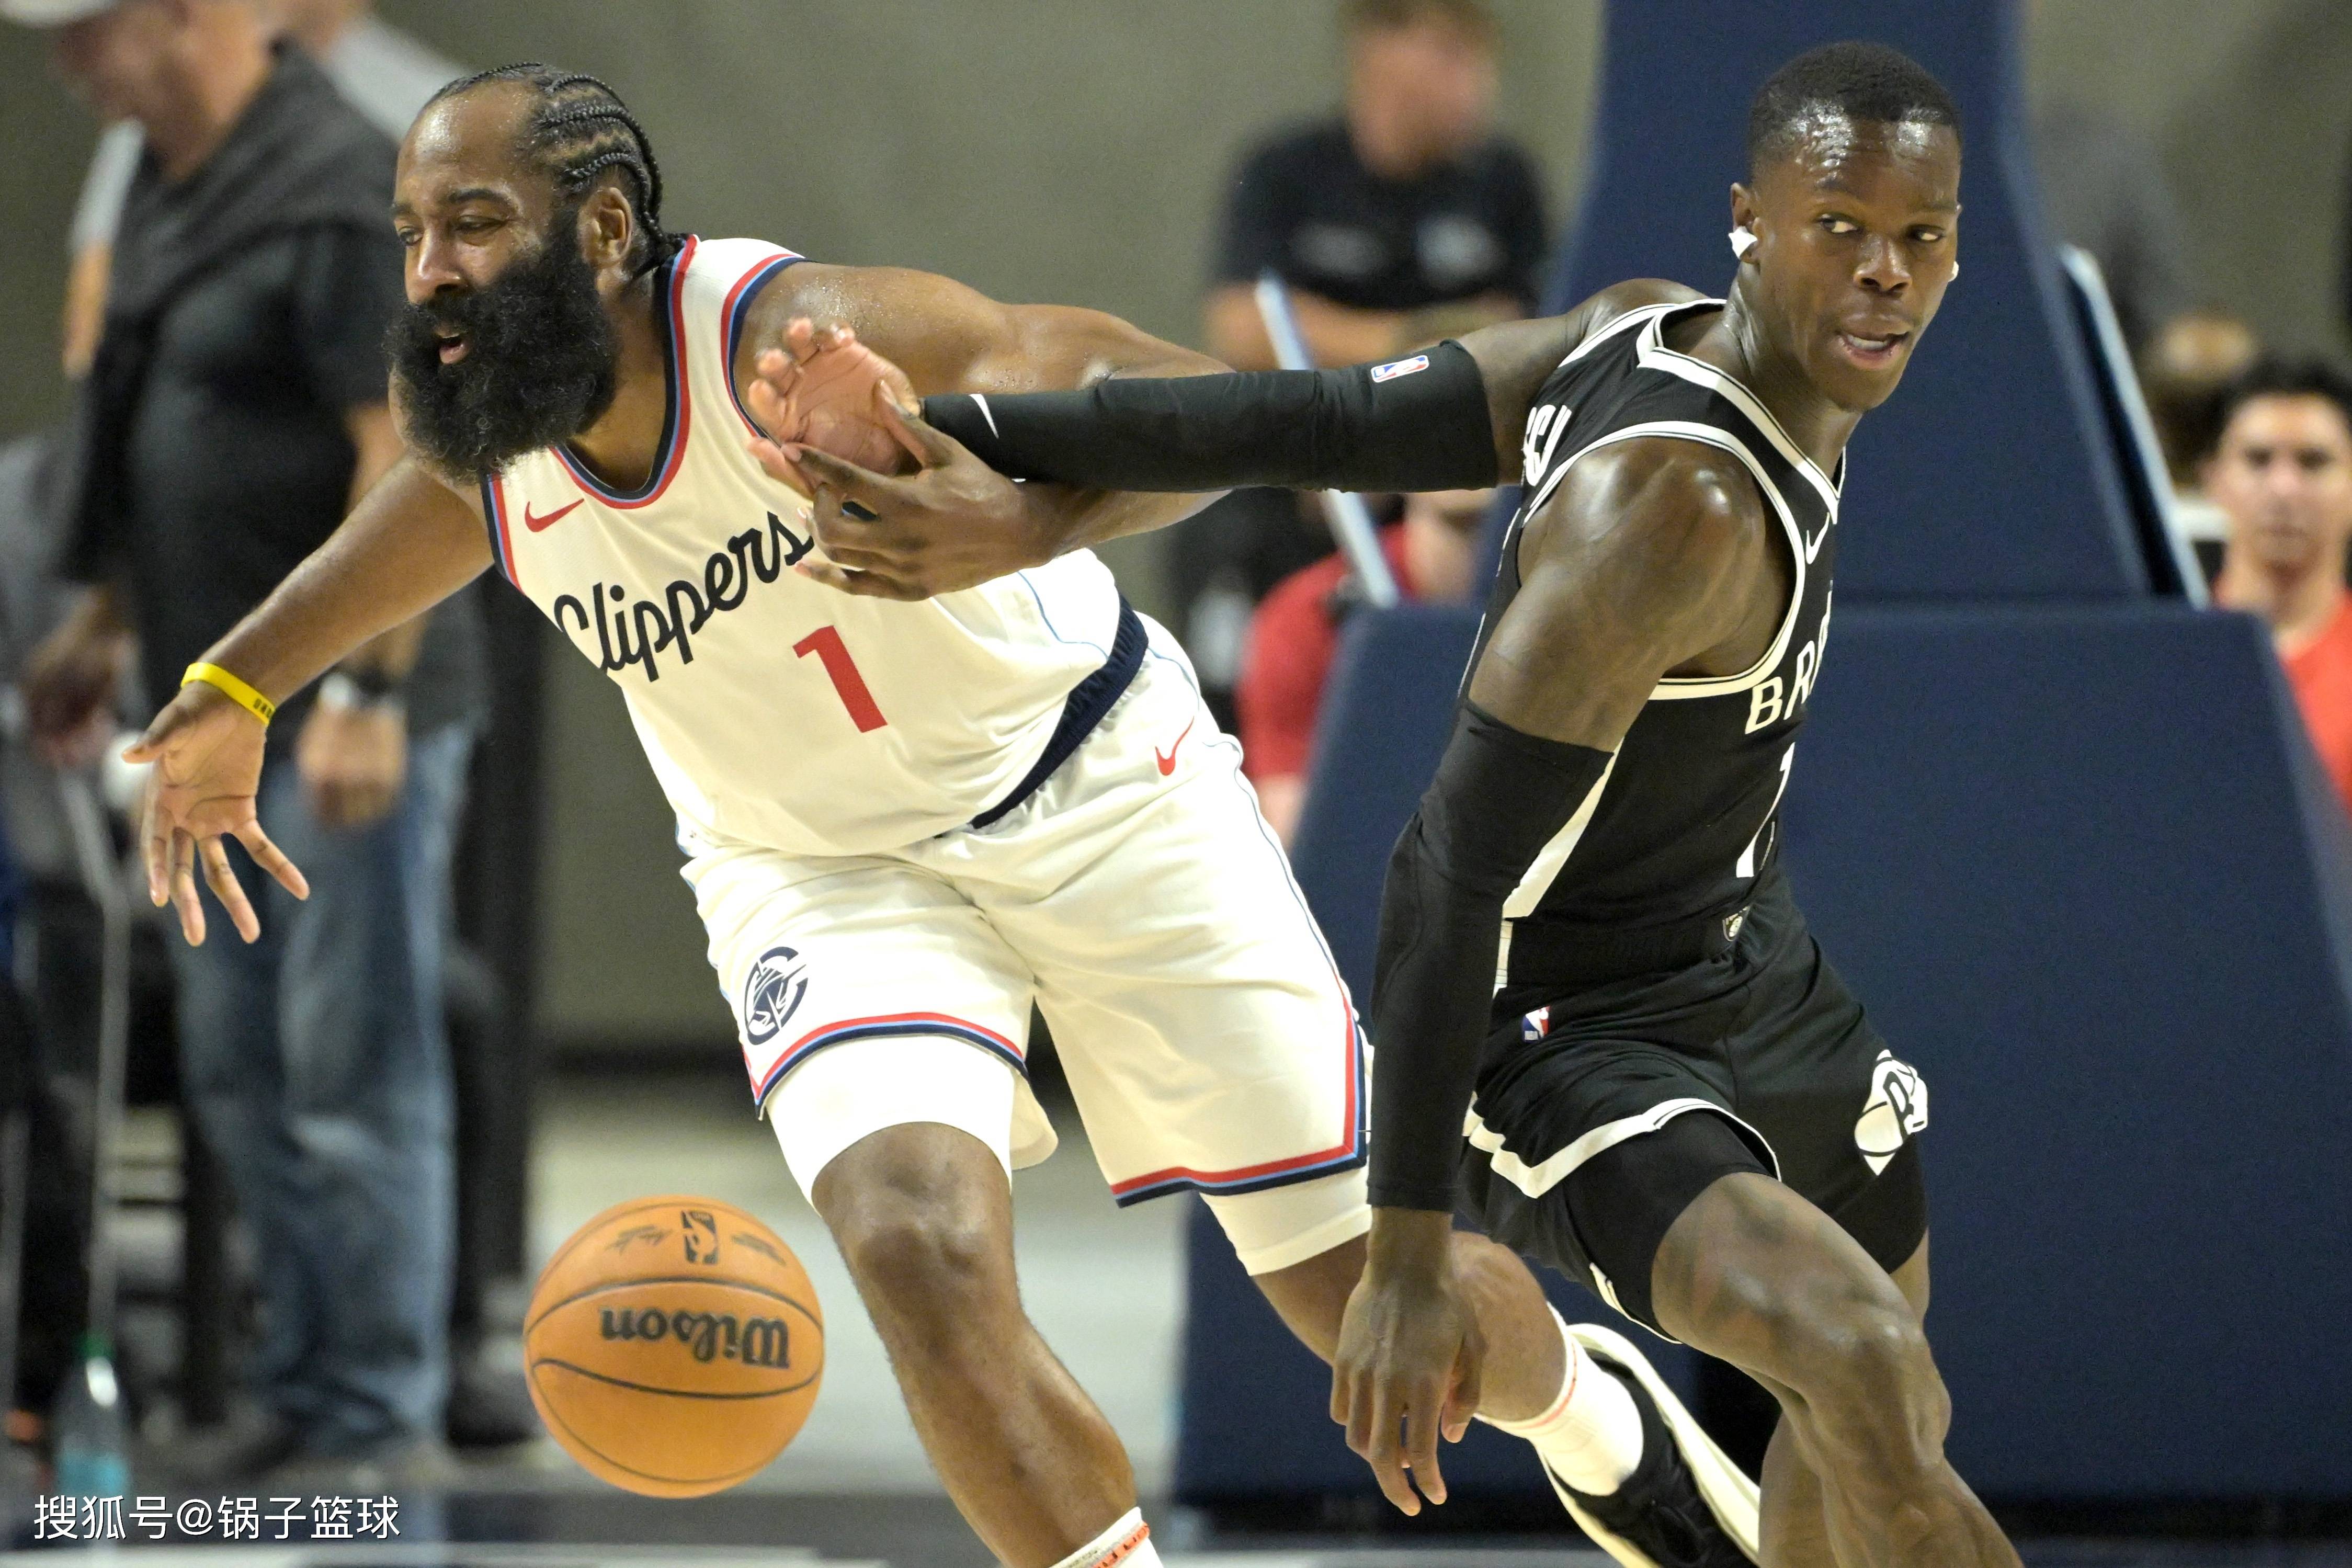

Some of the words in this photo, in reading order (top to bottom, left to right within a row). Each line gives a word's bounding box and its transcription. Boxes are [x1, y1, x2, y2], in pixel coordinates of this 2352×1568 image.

[554, 511, 815, 683] Clippers
[793, 625, 888, 733] 1
[600, 1309, 790, 1369] Wilson
